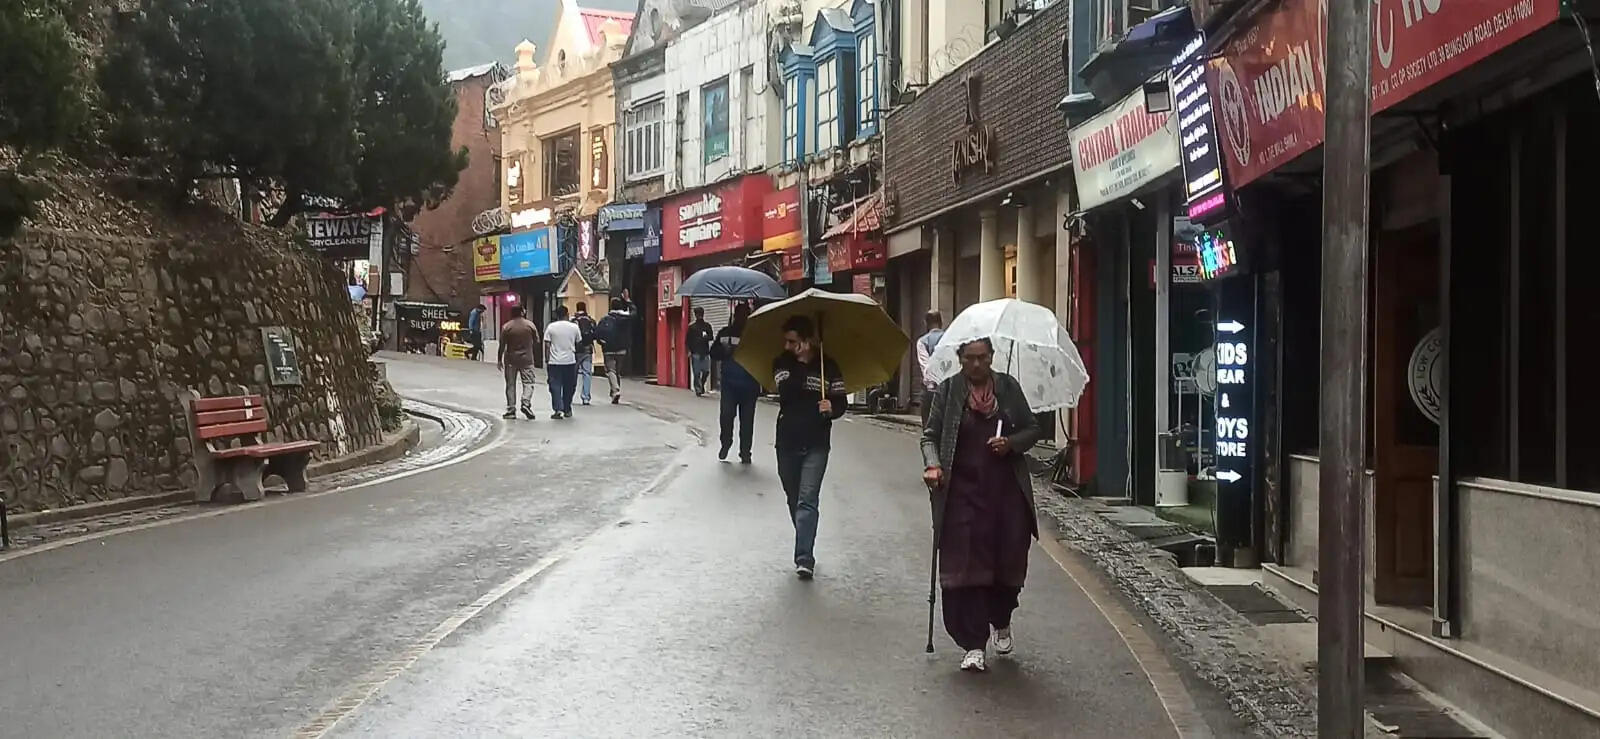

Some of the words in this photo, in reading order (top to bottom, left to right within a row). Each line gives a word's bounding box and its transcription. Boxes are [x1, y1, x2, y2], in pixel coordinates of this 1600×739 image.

[1254, 40, 1315, 125] INDIAN
[1078, 123, 1119, 172] CENTRAL
[1221, 392, 1230, 408] &
[1216, 442, 1247, 457] TORE
